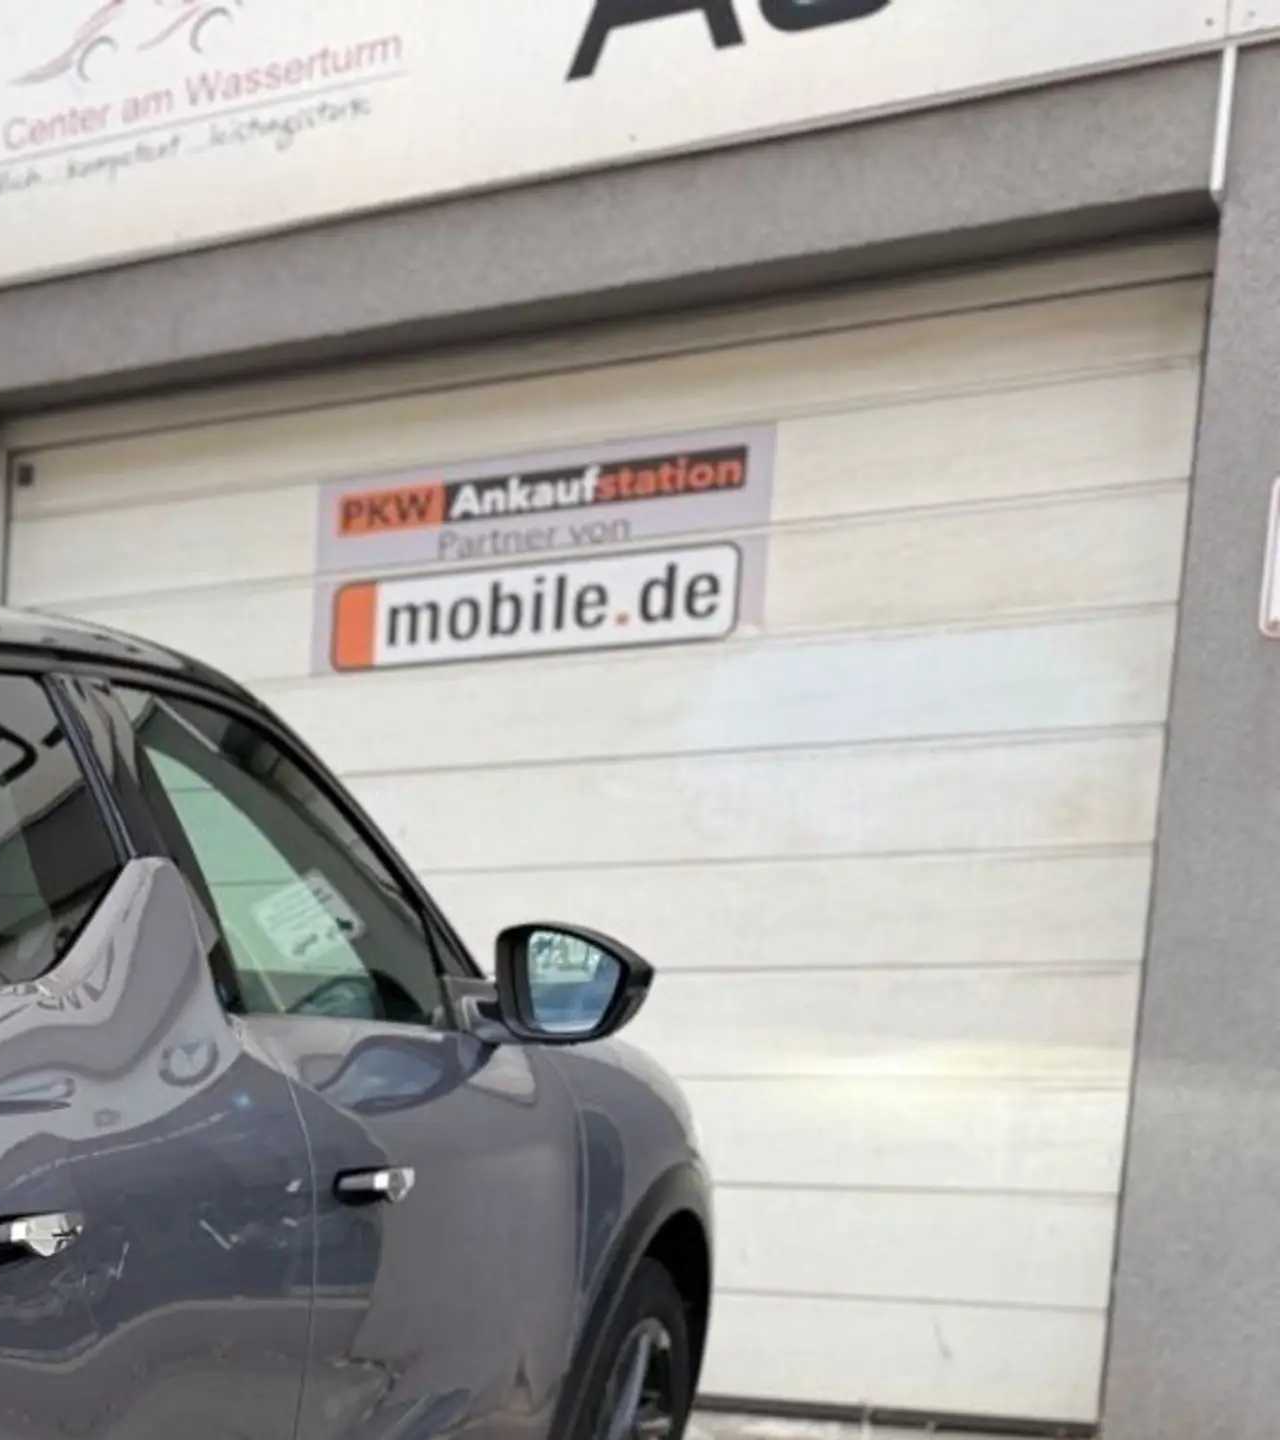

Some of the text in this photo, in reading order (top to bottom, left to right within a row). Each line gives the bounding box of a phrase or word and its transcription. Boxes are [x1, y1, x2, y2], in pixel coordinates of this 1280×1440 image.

[2, 102, 111, 151] Center
[121, 88, 174, 124] am
[184, 34, 403, 107] Wasserturm
[340, 455, 743, 533] PKW Ankaufstation
[439, 516, 632, 562] Partner von
[385, 562, 721, 648] mobile.de
